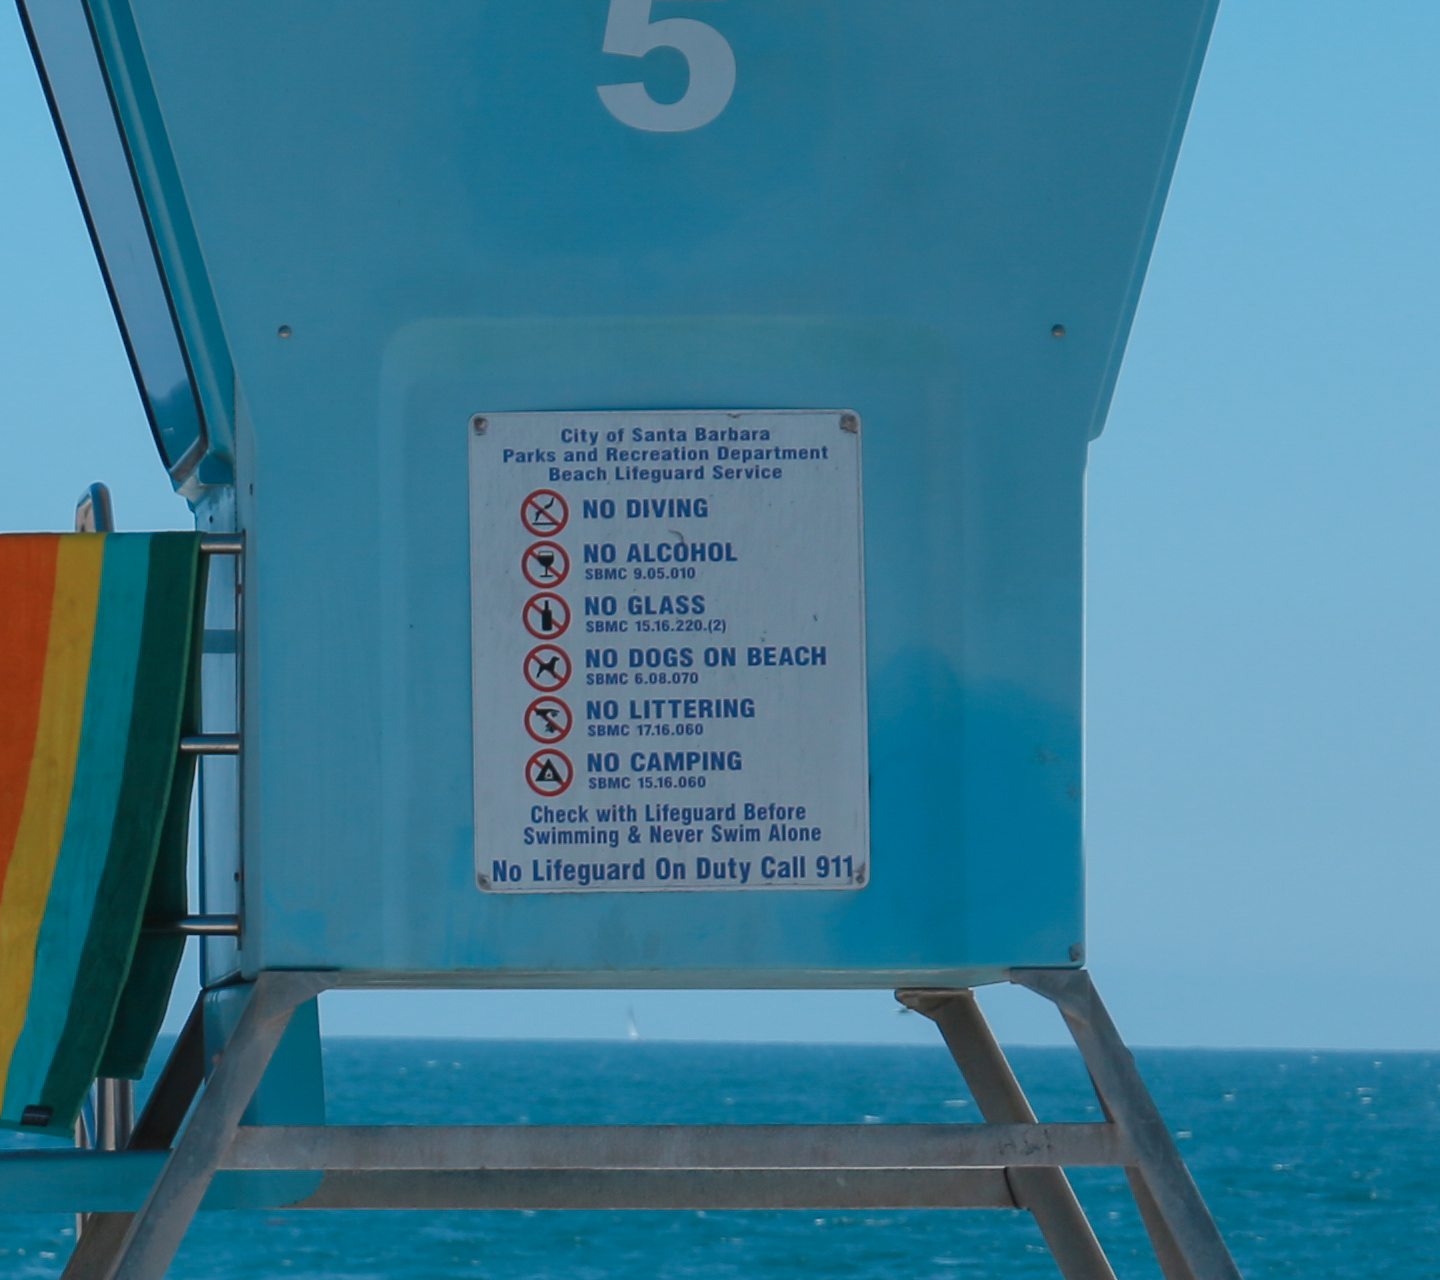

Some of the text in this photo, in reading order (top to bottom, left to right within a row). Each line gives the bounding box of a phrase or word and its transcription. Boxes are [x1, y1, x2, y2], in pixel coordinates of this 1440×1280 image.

[560, 426, 771, 447] City of Santa Barbara
[502, 445, 829, 464] Parks and Recreation Department
[548, 464, 783, 485] Beach Lifeguard Service
[582, 497, 709, 520] NO DIVING
[583, 541, 738, 564] NO ALCOHOL
[584, 566, 696, 581] SBMC 9.05.010
[584, 594, 706, 617] NO GLASS
[585, 618, 727, 635] SBMC 15.16.220.(2)
[585, 645, 827, 669] NO DOGS ON BEACH
[585, 671, 699, 687] SBMC 6.08.070
[586, 697, 756, 721] NO LITTERING
[587, 722, 704, 738] SBMC 17.16.060
[586, 750, 743, 773] NO CAMPING
[588, 775, 707, 791] SBMC 15.16.060
[530, 802, 807, 827] Check with Lifeguard Before
[523, 823, 822, 849] Swimming & Never Swim Alone
[492, 855, 855, 887] No Lifeguard On Duty Call 911
